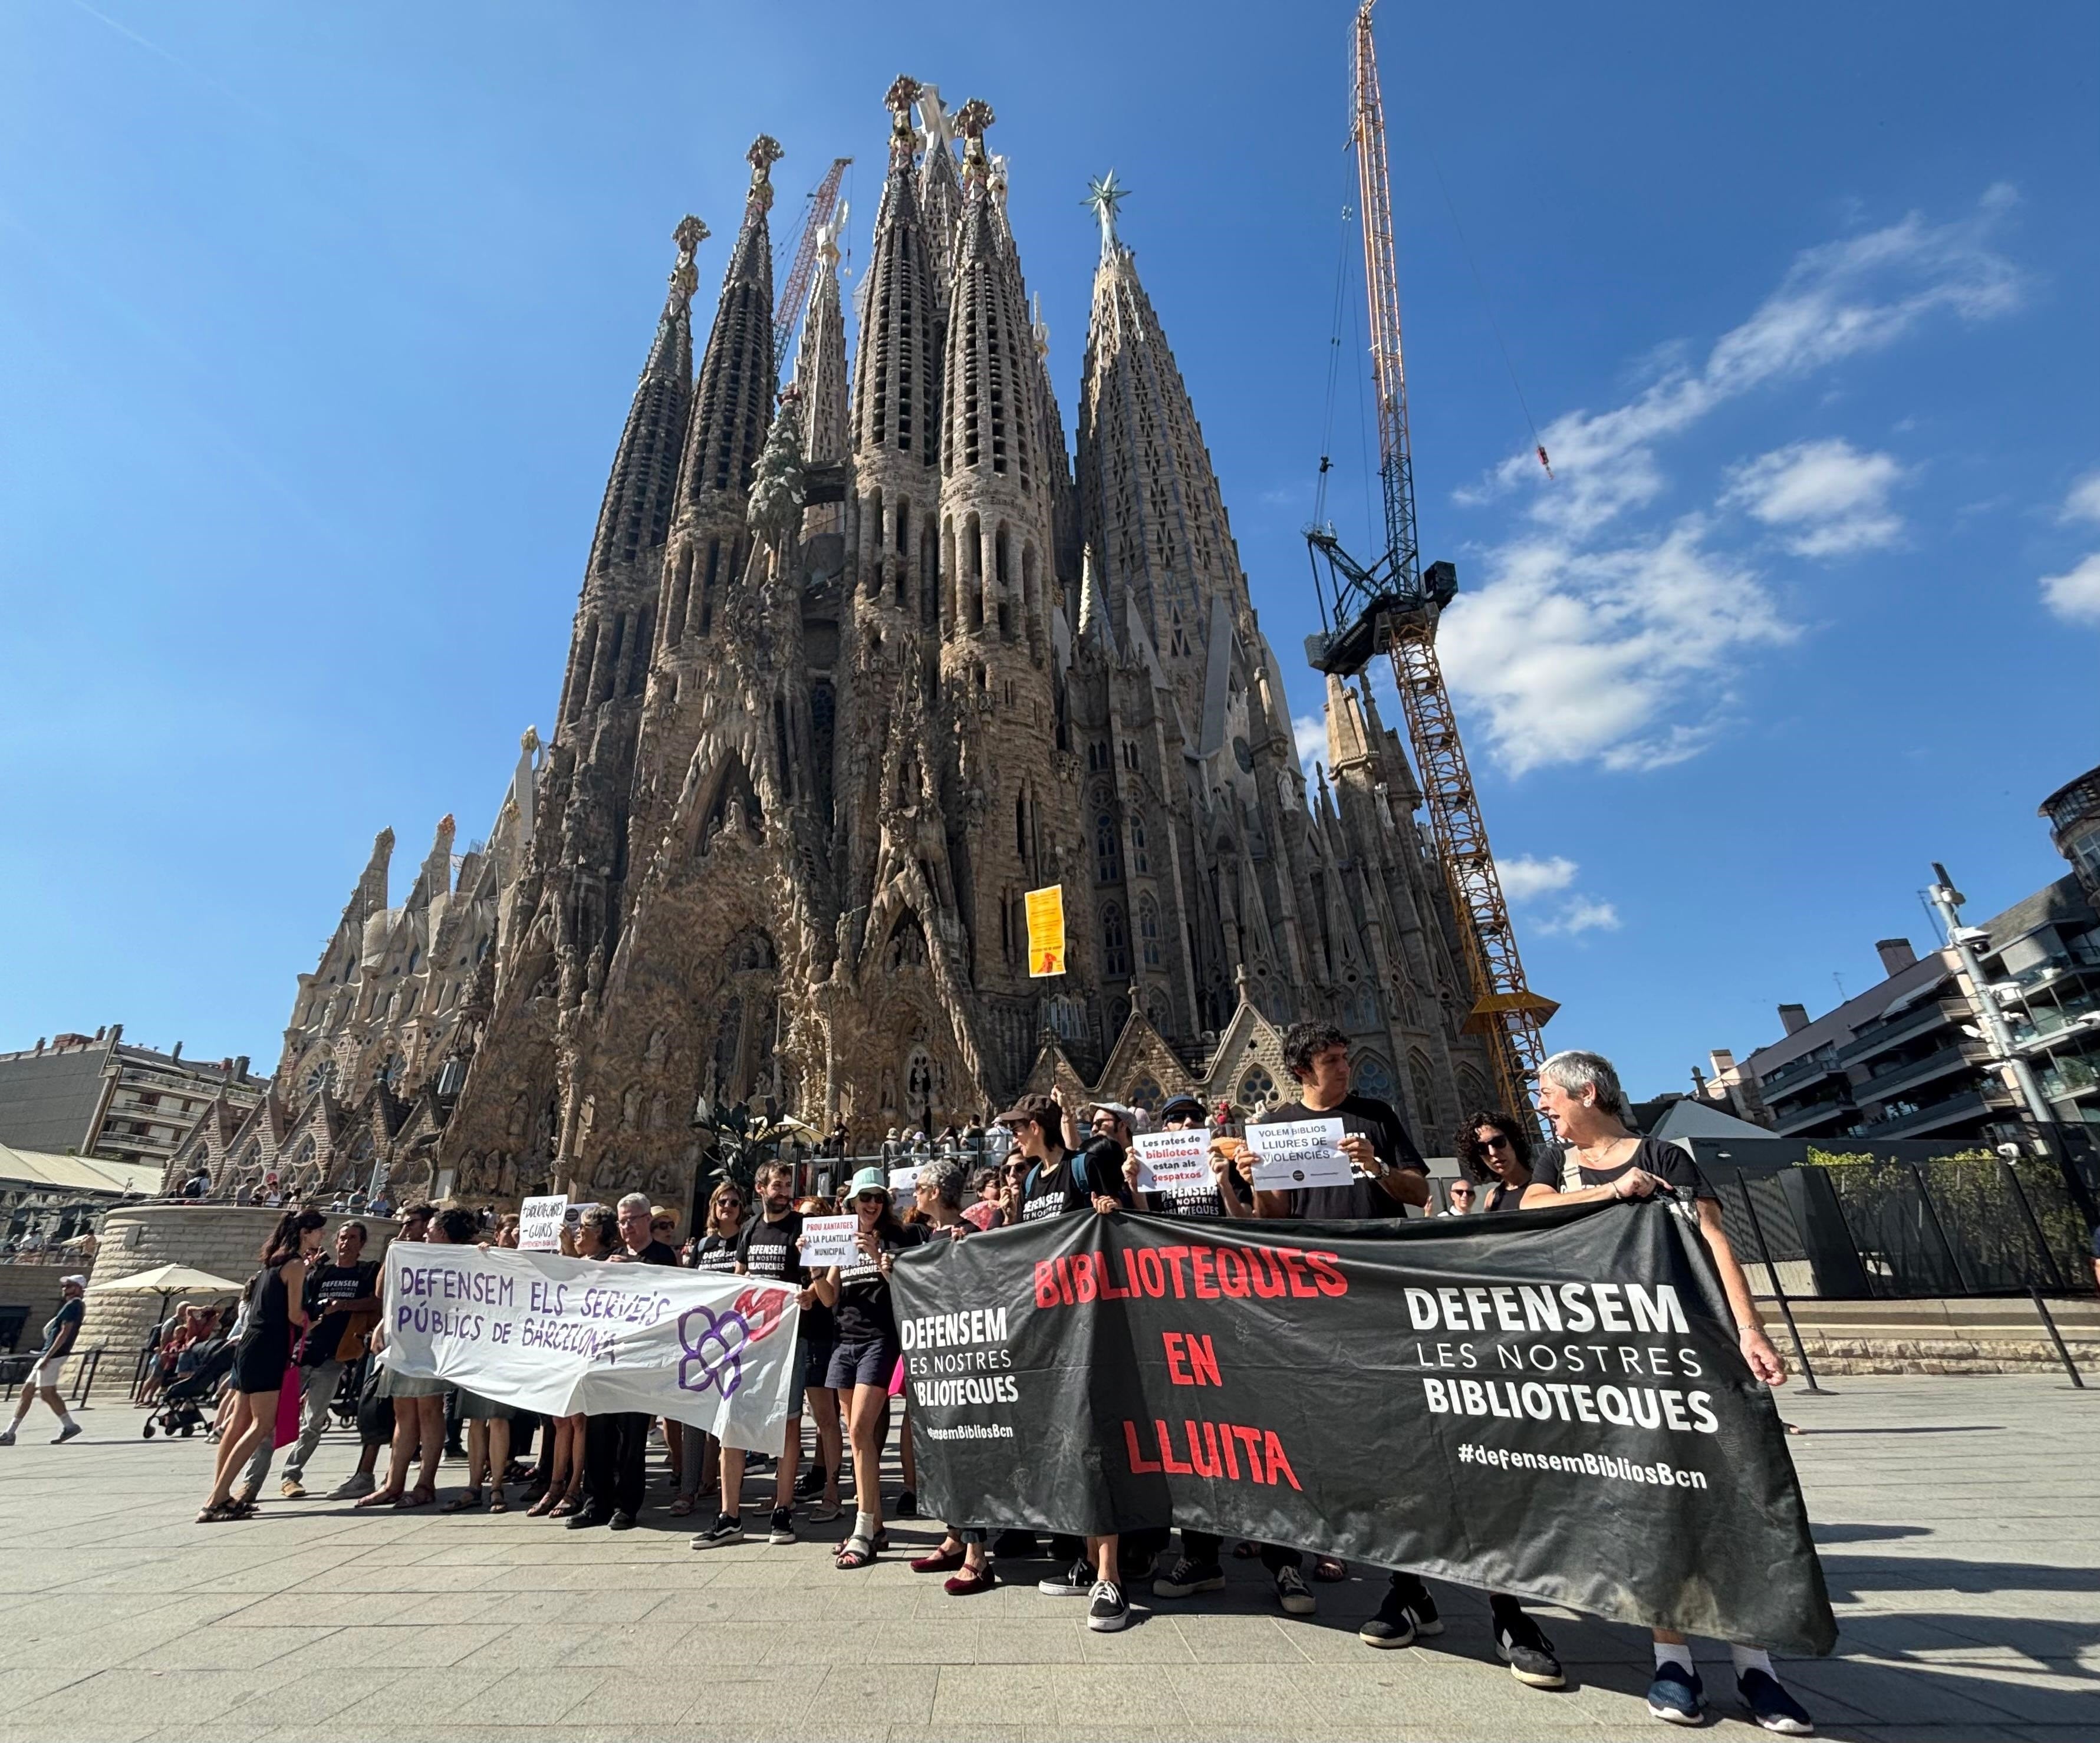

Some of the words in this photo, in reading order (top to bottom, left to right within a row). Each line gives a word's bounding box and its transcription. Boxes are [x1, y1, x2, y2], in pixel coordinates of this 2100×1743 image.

[1259, 1128, 1289, 1137] VOLEM
[1291, 1125, 1327, 1136] BIBLIOS
[1262, 1138, 1308, 1149] LLIURES
[1312, 1137, 1328, 1146] DE
[1146, 1149, 1200, 1159] biblioteca
[1153, 1162, 1179, 1170] estan
[1182, 1159, 1196, 1168] als
[1264, 1149, 1330, 1163] VIOLÈNCIES
[1151, 1171, 1202, 1182] despatxos
[1161, 1205, 1219, 1216] BLIOTEQUES
[807, 1223, 822, 1231] PROU
[813, 1235, 820, 1243] LA
[821, 1234, 852, 1243] PLANTILLA
[814, 1247, 846, 1256] MUNICIPAL
[401, 1267, 513, 1307] DEFENSEM
[531, 1281, 568, 1316] ELS
[1034, 1246, 1348, 1309] BIBLIOTEQUES
[1404, 1283, 1690, 1334] DEFENSEM
[492, 1323, 512, 1344] DE
[522, 1317, 617, 1365] BARCELONA
[901, 1307, 1007, 1350] DEFENSEM
[910, 1357, 927, 1375] ES
[934, 1349, 1011, 1373] NOSTRES
[1161, 1332, 1222, 1387] EN
[1417, 1343, 1477, 1368] LES
[1496, 1344, 1702, 1378] NOSTRES
[913, 1375, 1019, 1406] BLIOTEQUES
[1423, 1378, 1719, 1434] BIBLIOTEQUES
[1123, 1419, 1303, 1491] LLUITA
[1458, 1443, 1707, 1490] #defensemBibliosBcn
